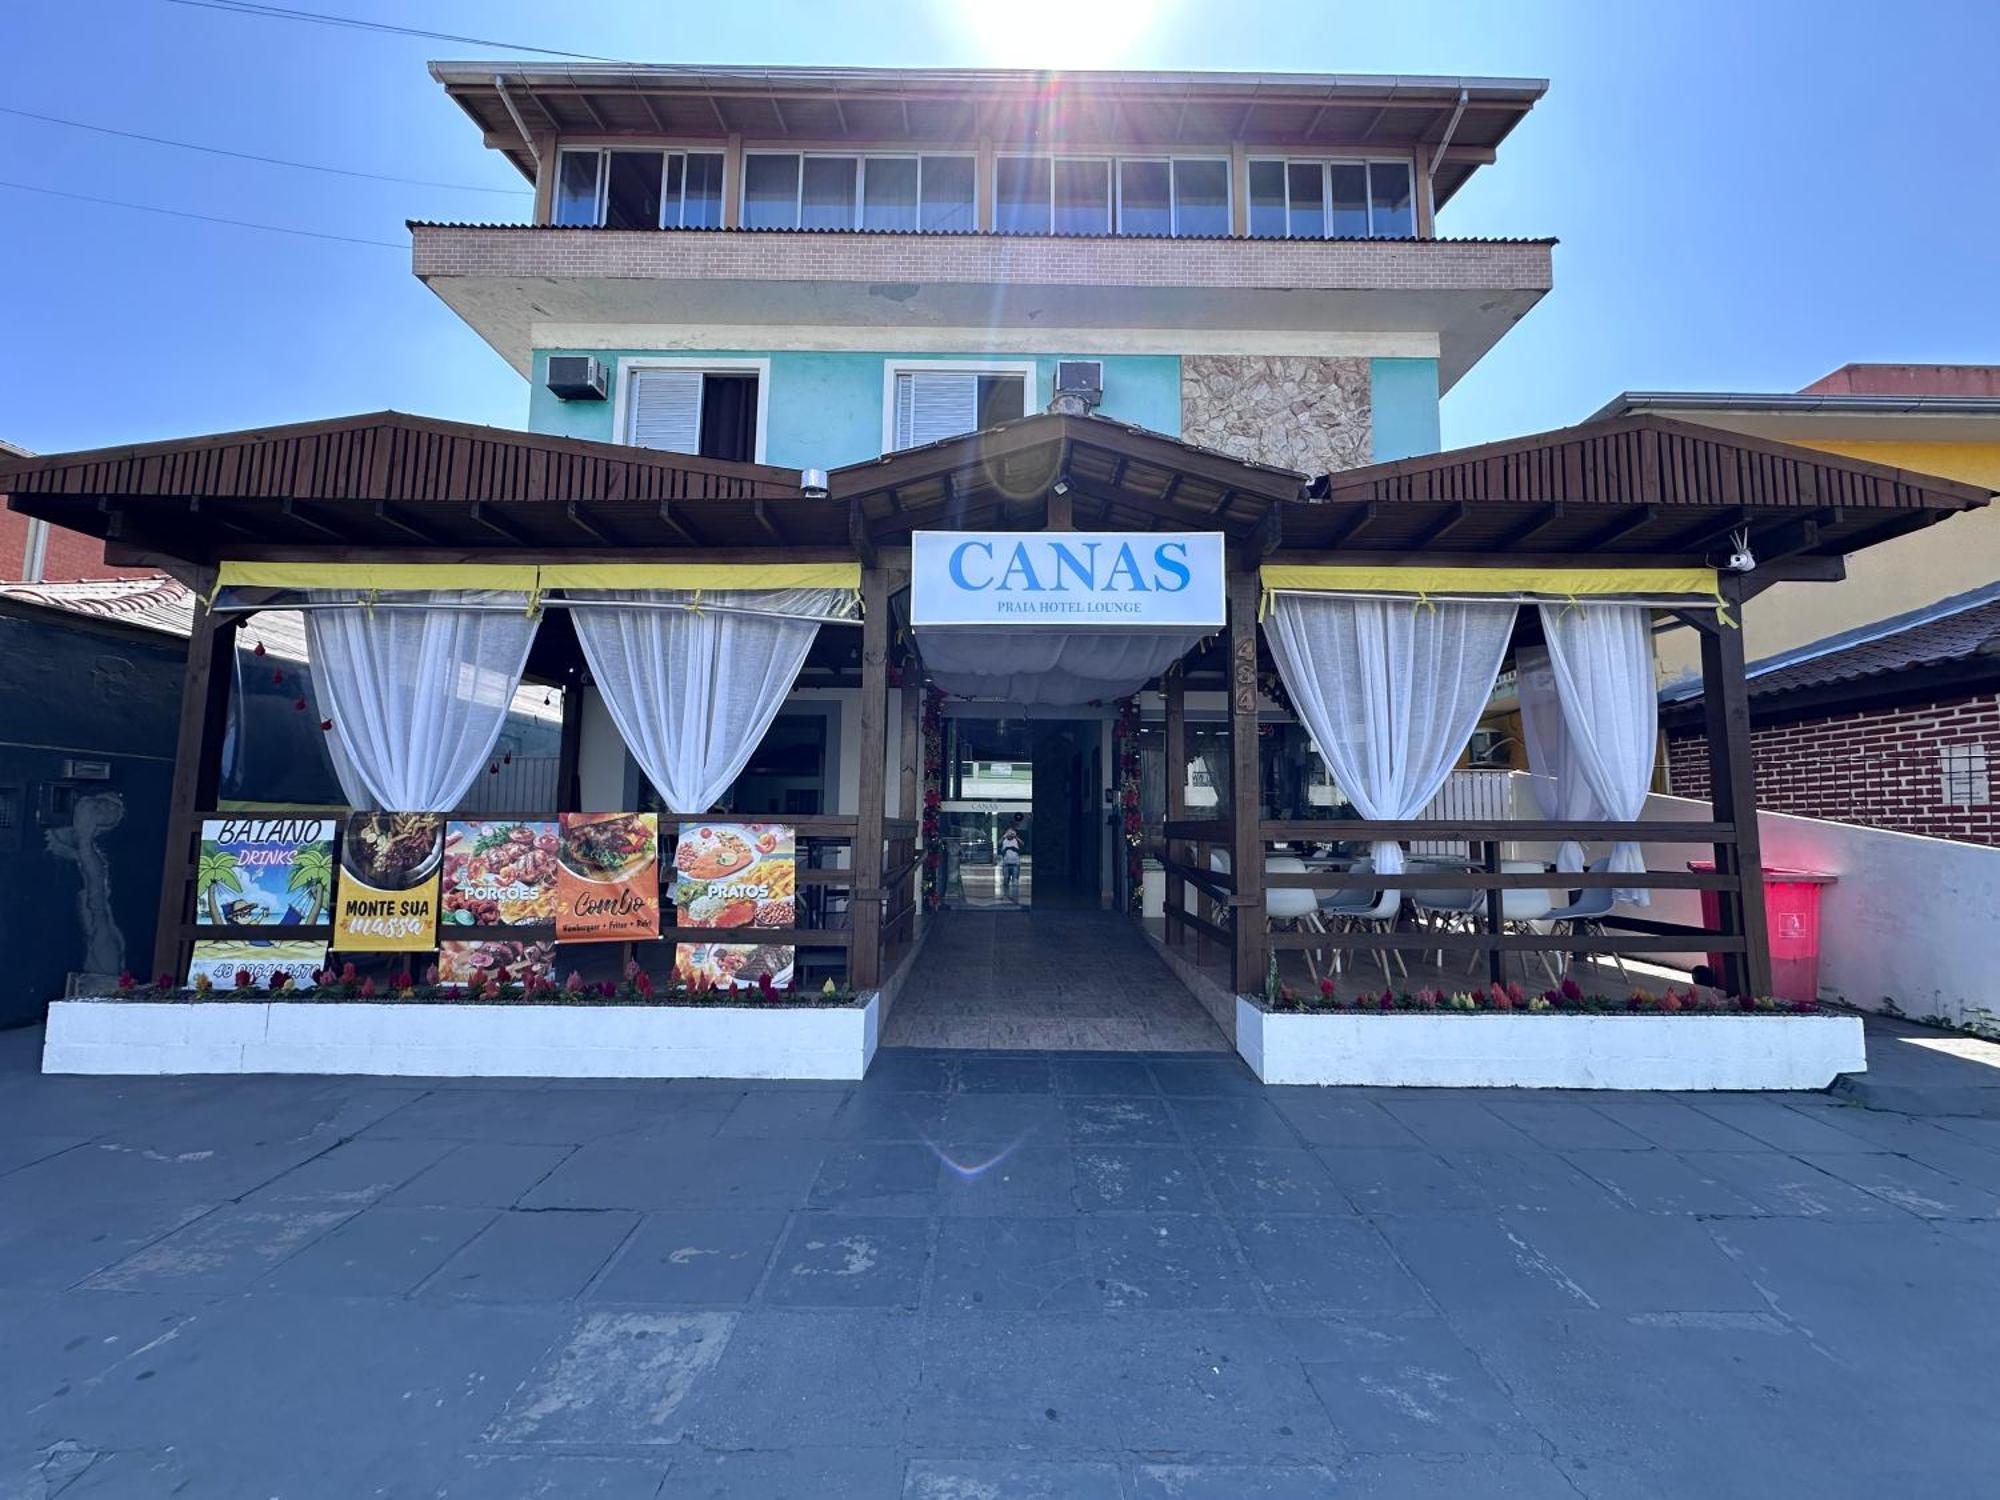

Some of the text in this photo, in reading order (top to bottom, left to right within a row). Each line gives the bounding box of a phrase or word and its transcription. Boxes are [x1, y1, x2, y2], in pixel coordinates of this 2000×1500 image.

[948, 541, 1191, 592] CANAS
[998, 602, 1143, 613] PRAIA HOTEL LOUNGE
[217, 819, 322, 845] BAIANO
[237, 849, 298, 866] DRINKS
[707, 884, 769, 899] PRATOS
[346, 900, 429, 917] MONTE SUA
[574, 888, 645, 917] Combo
[349, 916, 425, 938] massa
[213, 963, 234, 979] 48
